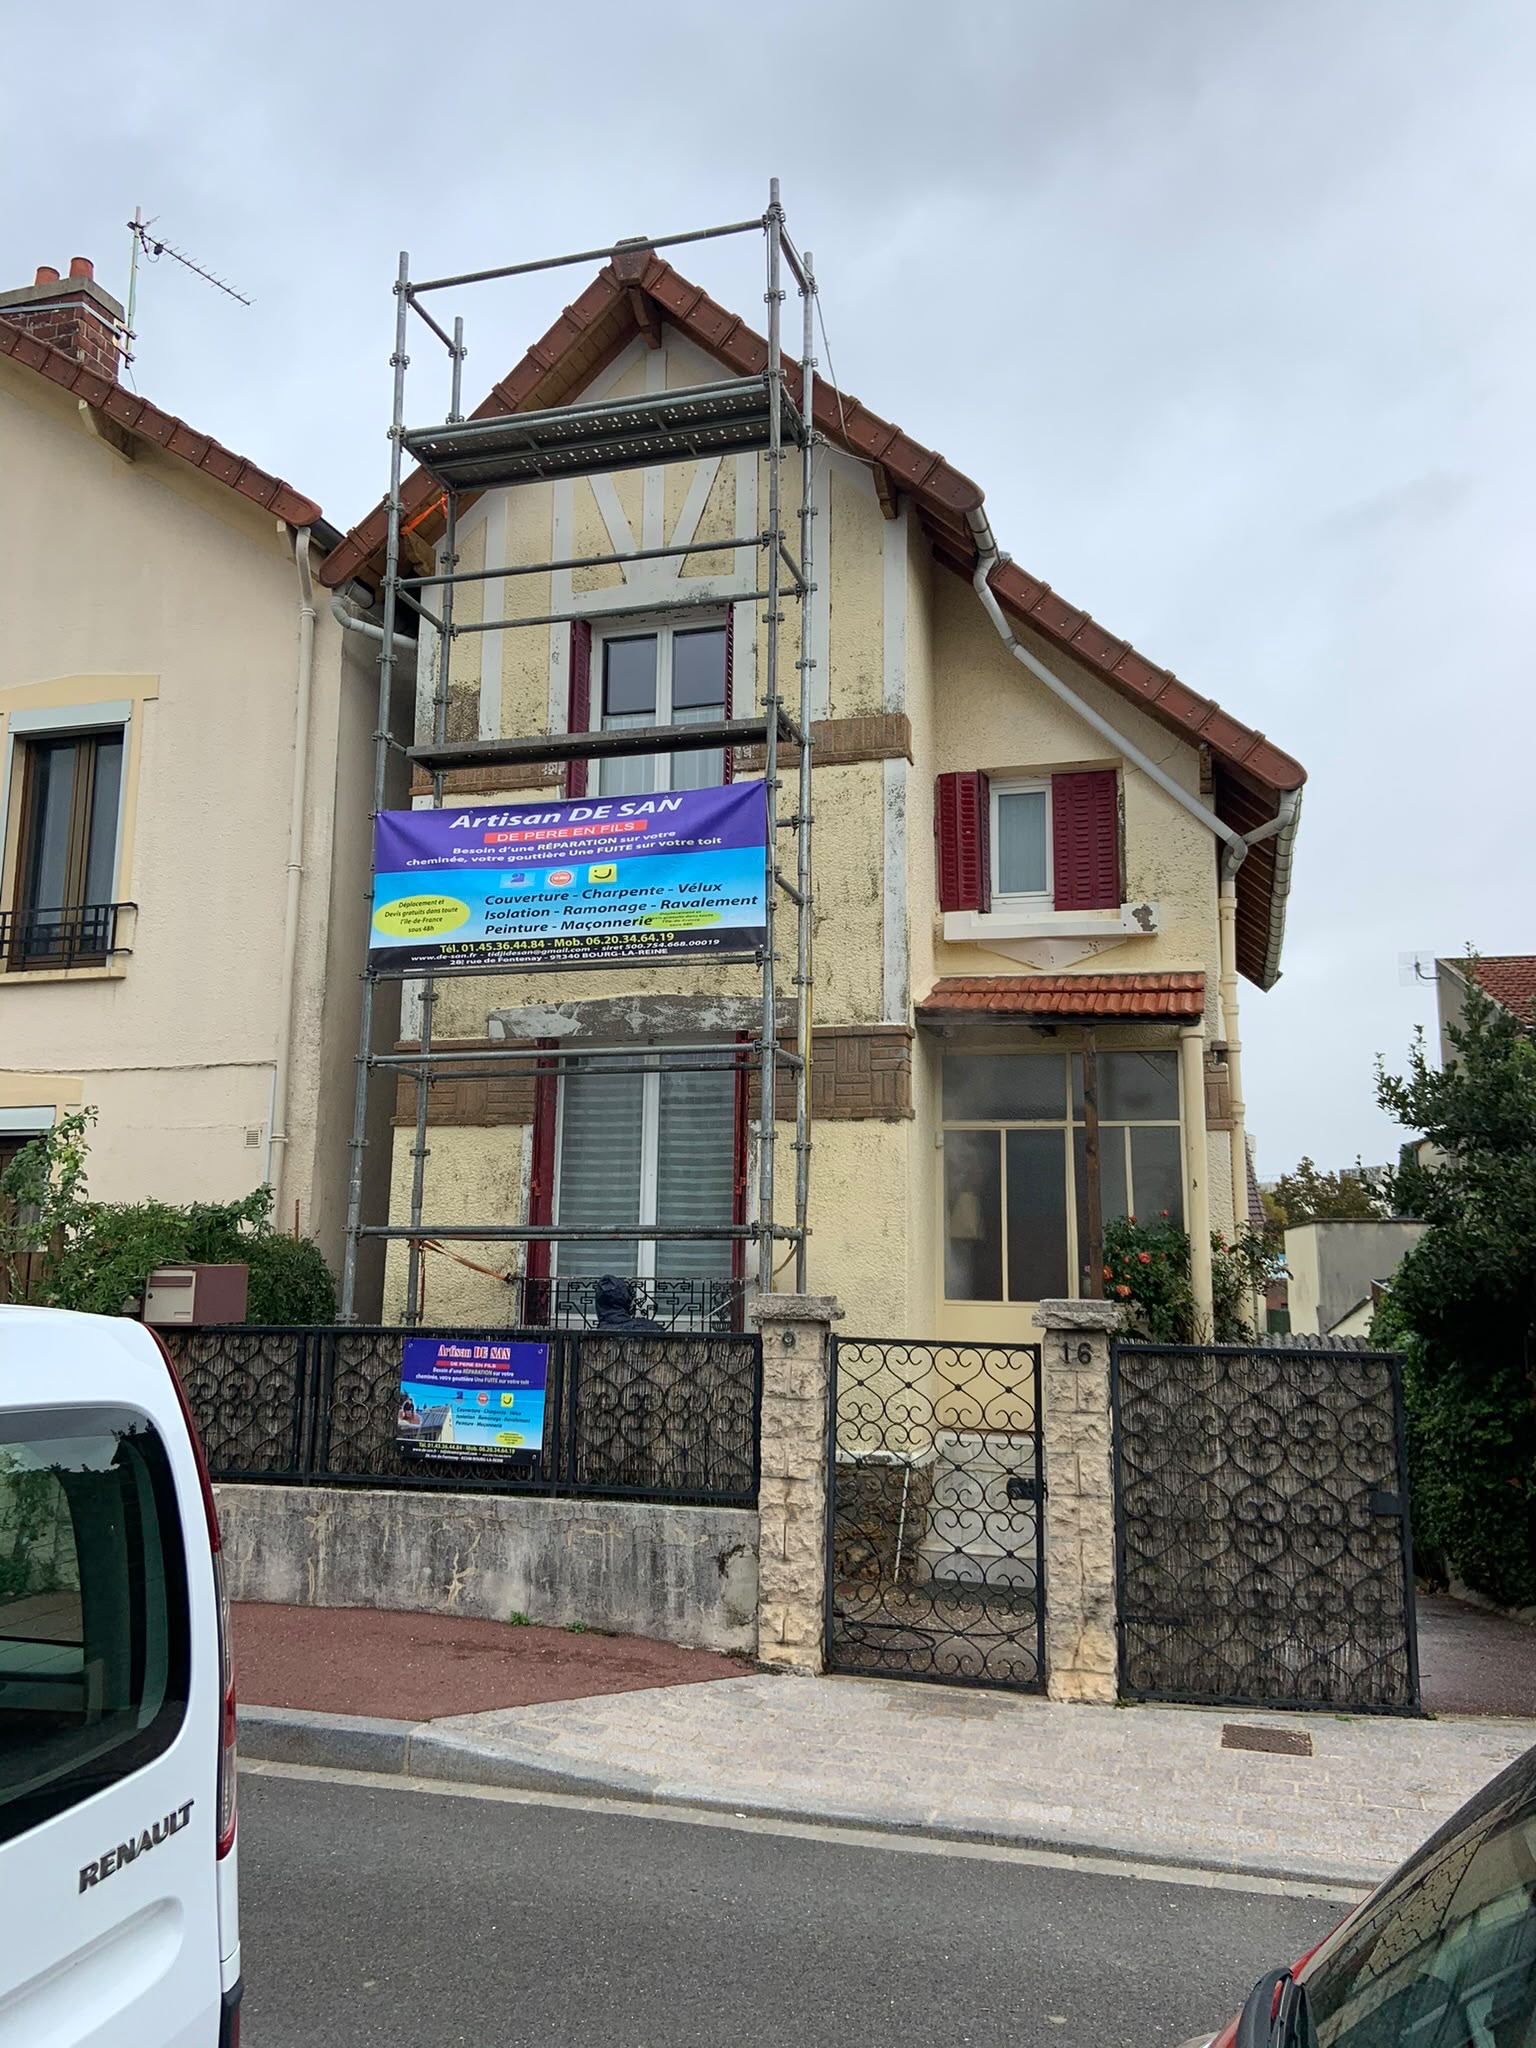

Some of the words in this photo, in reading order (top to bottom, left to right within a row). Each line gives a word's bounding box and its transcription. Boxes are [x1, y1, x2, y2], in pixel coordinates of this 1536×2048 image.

[449, 812, 561, 829] Artisan
[569, 804, 612, 822] DE
[617, 797, 684, 818] SAN
[453, 847, 495, 855] Besoin
[498, 845, 534, 853] d'une
[537, 837, 617, 850] RÉPARATION
[620, 836, 641, 844] sur
[643, 831, 676, 840] votre
[497, 832, 519, 842] DE
[524, 829, 568, 840] PERE
[573, 826, 596, 836] EN
[600, 822, 636, 833] FILS
[406, 855, 468, 866] cheminée,
[507, 849, 567, 863] gouttière
[569, 848, 594, 857] Une
[597, 844, 633, 854] FUITE
[659, 839, 694, 847] votre
[698, 837, 722, 845] toit
[398, 899, 437, 908] Déplacement
[485, 891, 569, 905] Couverture
[582, 886, 665, 899] Charpente
[678, 882, 723, 893] Vélux
[402, 909, 425, 917] gratuits
[485, 908, 550, 920] Isolation
[563, 902, 647, 916] Ramonage
[660, 896, 758, 909] Ravalement
[485, 923, 548, 934] Peinture
[561, 915, 652, 931] Maçonnerie
[440, 944, 459, 954] Tél.
[461, 940, 545, 952] 01.45.36.44.84
[554, 937, 584, 948] Mob.
[586, 932, 675, 945] 06.20.34.64.19
[582, 949, 668, 959] BOURG-LA-REINE
[411, 952, 477, 961] www.de-san.fr
[438, 1344, 472, 1358] Artisan
[473, 1346, 489, 1359] DE
[490, 1347, 511, 1360] SAN
[1062, 1340, 1093, 1366] 16
[78, 1797, 195, 1895] RENAULT
